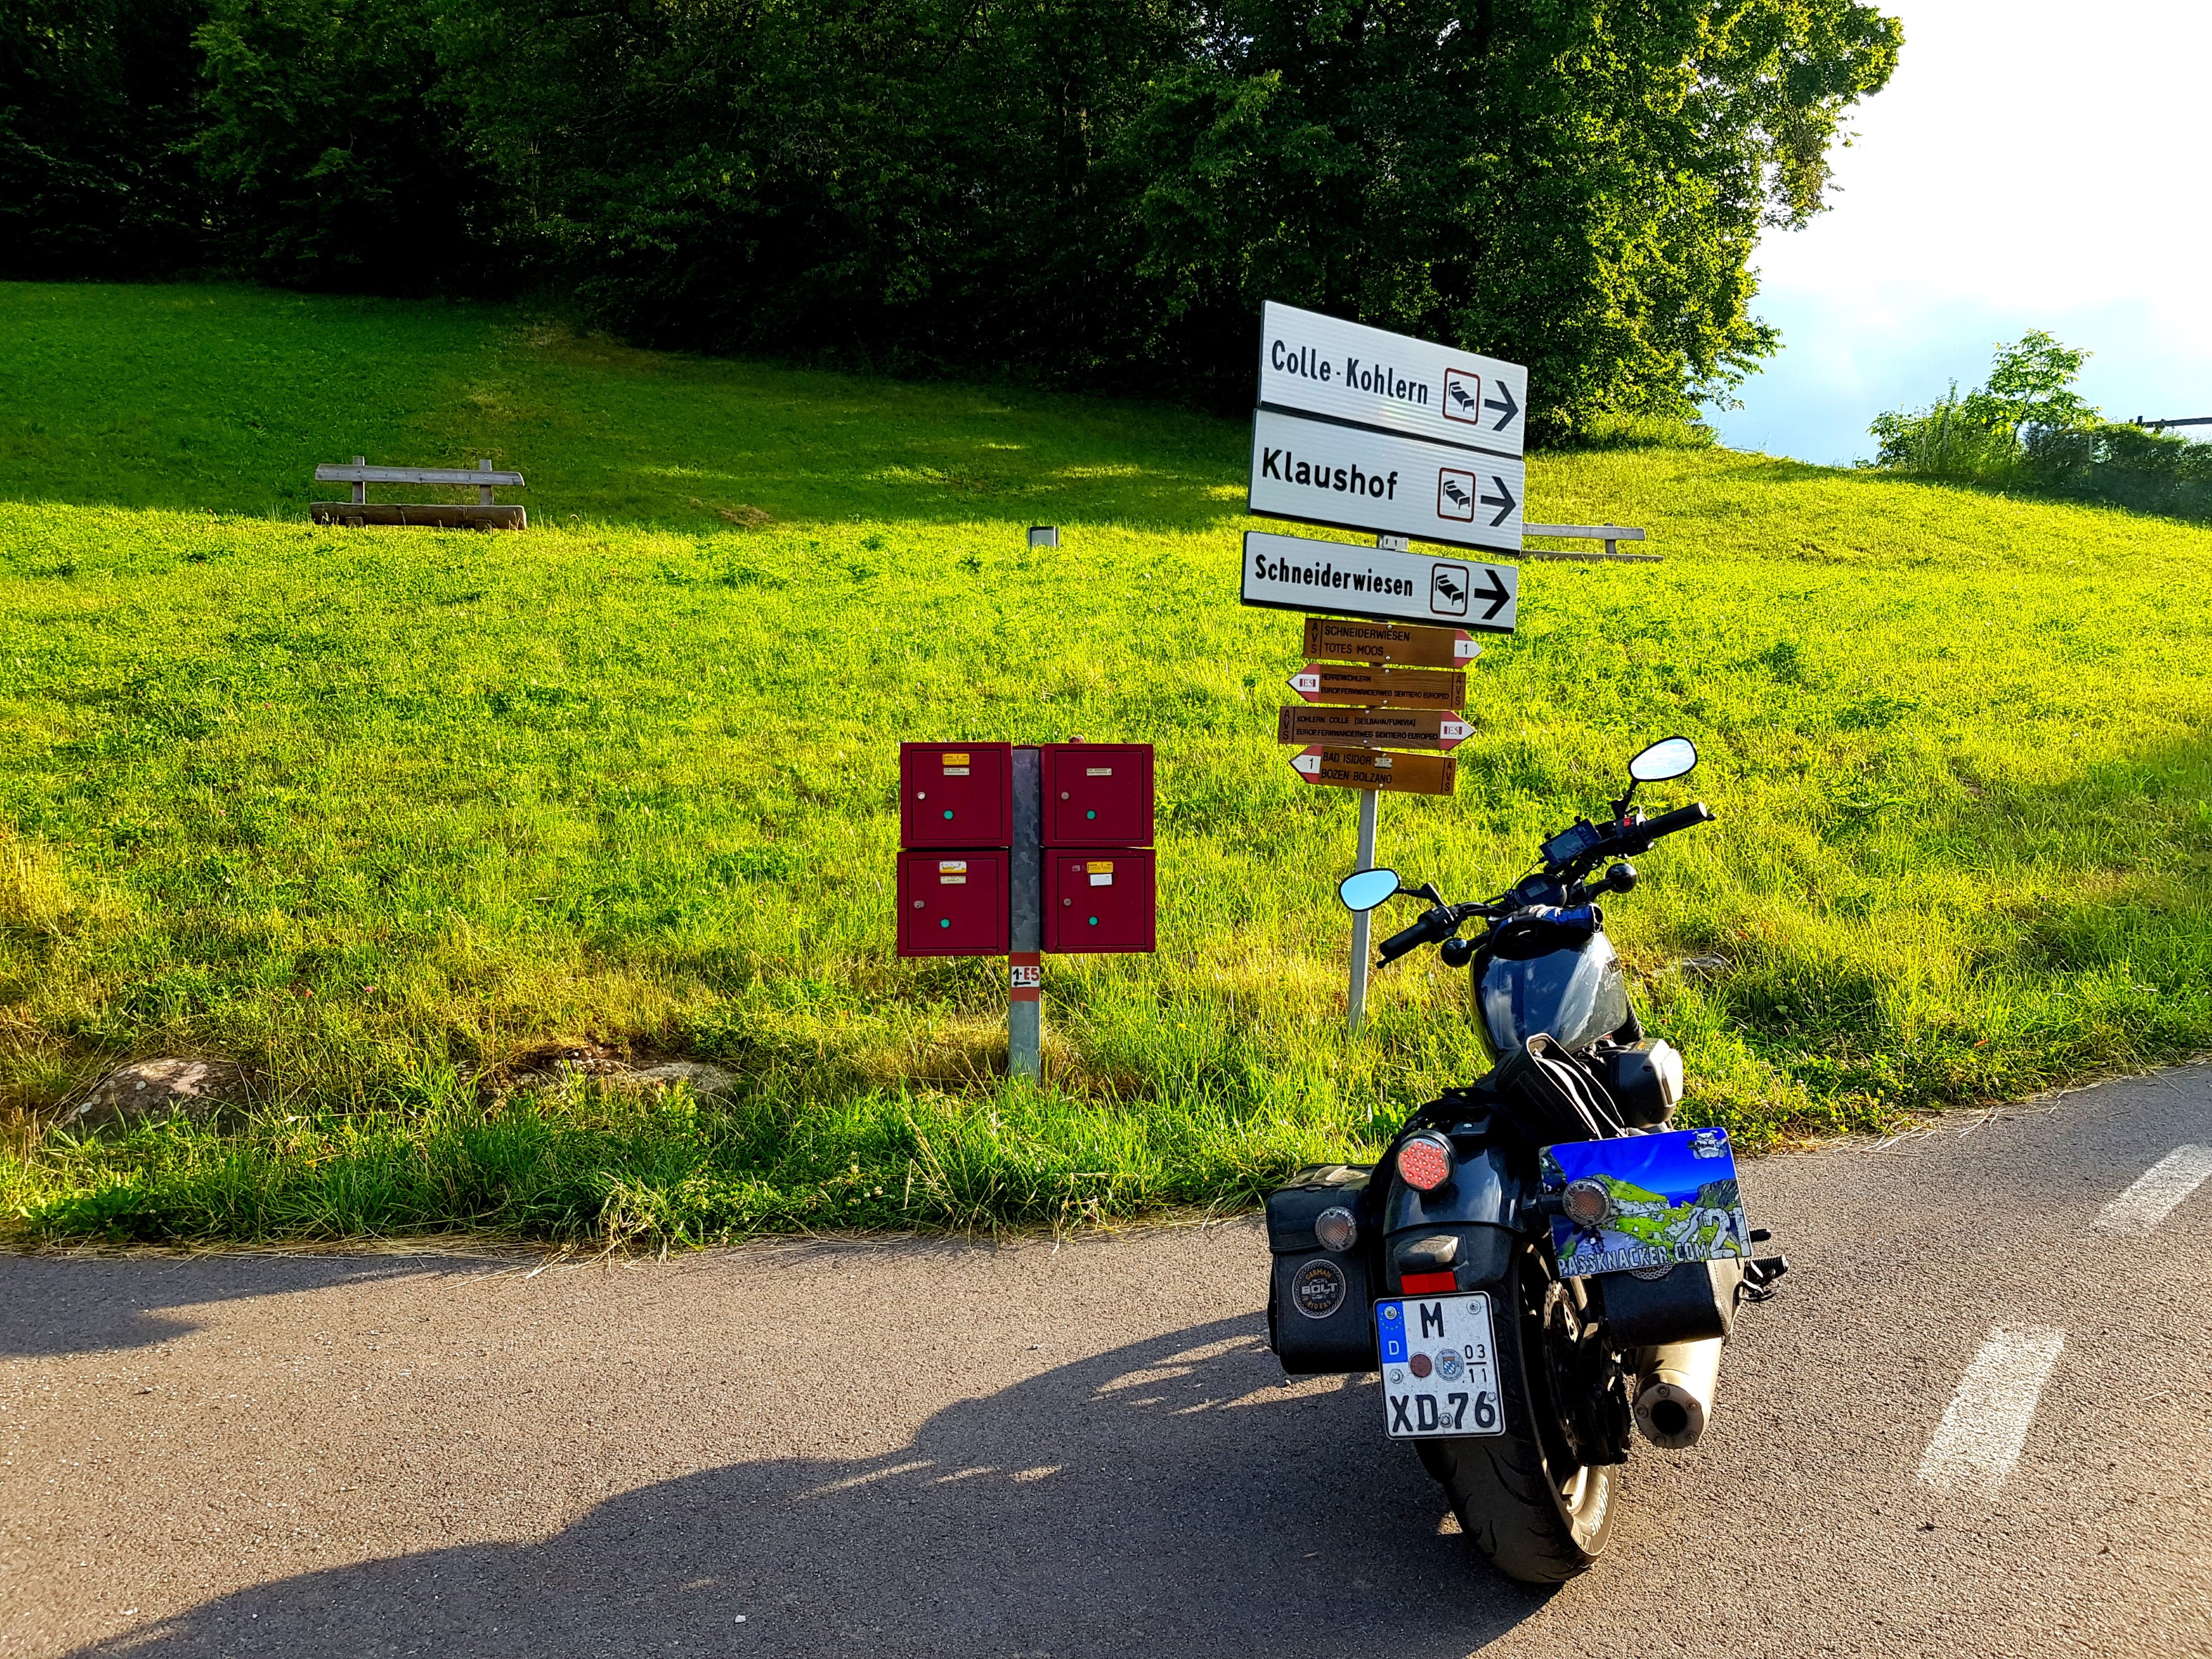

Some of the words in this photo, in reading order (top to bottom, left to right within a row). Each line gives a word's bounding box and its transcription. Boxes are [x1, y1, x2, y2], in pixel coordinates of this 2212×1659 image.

[1262, 447, 1398, 500] Klaushof
[1255, 554, 1413, 597] Schneiderwiesen
[1325, 625, 1410, 641] SCHNEIDERWIESEN
[1325, 643, 1352, 654] TOTES
[1357, 645, 1384, 656] MOOS
[1463, 643, 1468, 654] 1
[1303, 678, 1313, 687] E5
[1375, 731, 1407, 739] SENTIERO
[1448, 727, 1458, 735] E5
[1309, 757, 1314, 770] 1
[1322, 752, 1340, 762] BAD
[1342, 753, 1372, 765] ISIDOR
[1321, 768, 1350, 780] BOZEN
[1352, 772, 1393, 784] BOLZANO
[1557, 1241, 1708, 1277] PASSKNACKER.COM
[1305, 1268, 1332, 1280] GERMAN
[1301, 1282, 1338, 1295] BOLT
[1307, 1300, 1331, 1309] RIDERS
[1420, 1302, 1445, 1338] M
[1388, 1340, 1400, 1355] D
[1464, 1344, 1486, 1359] 03
[1468, 1368, 1488, 1383] 11
